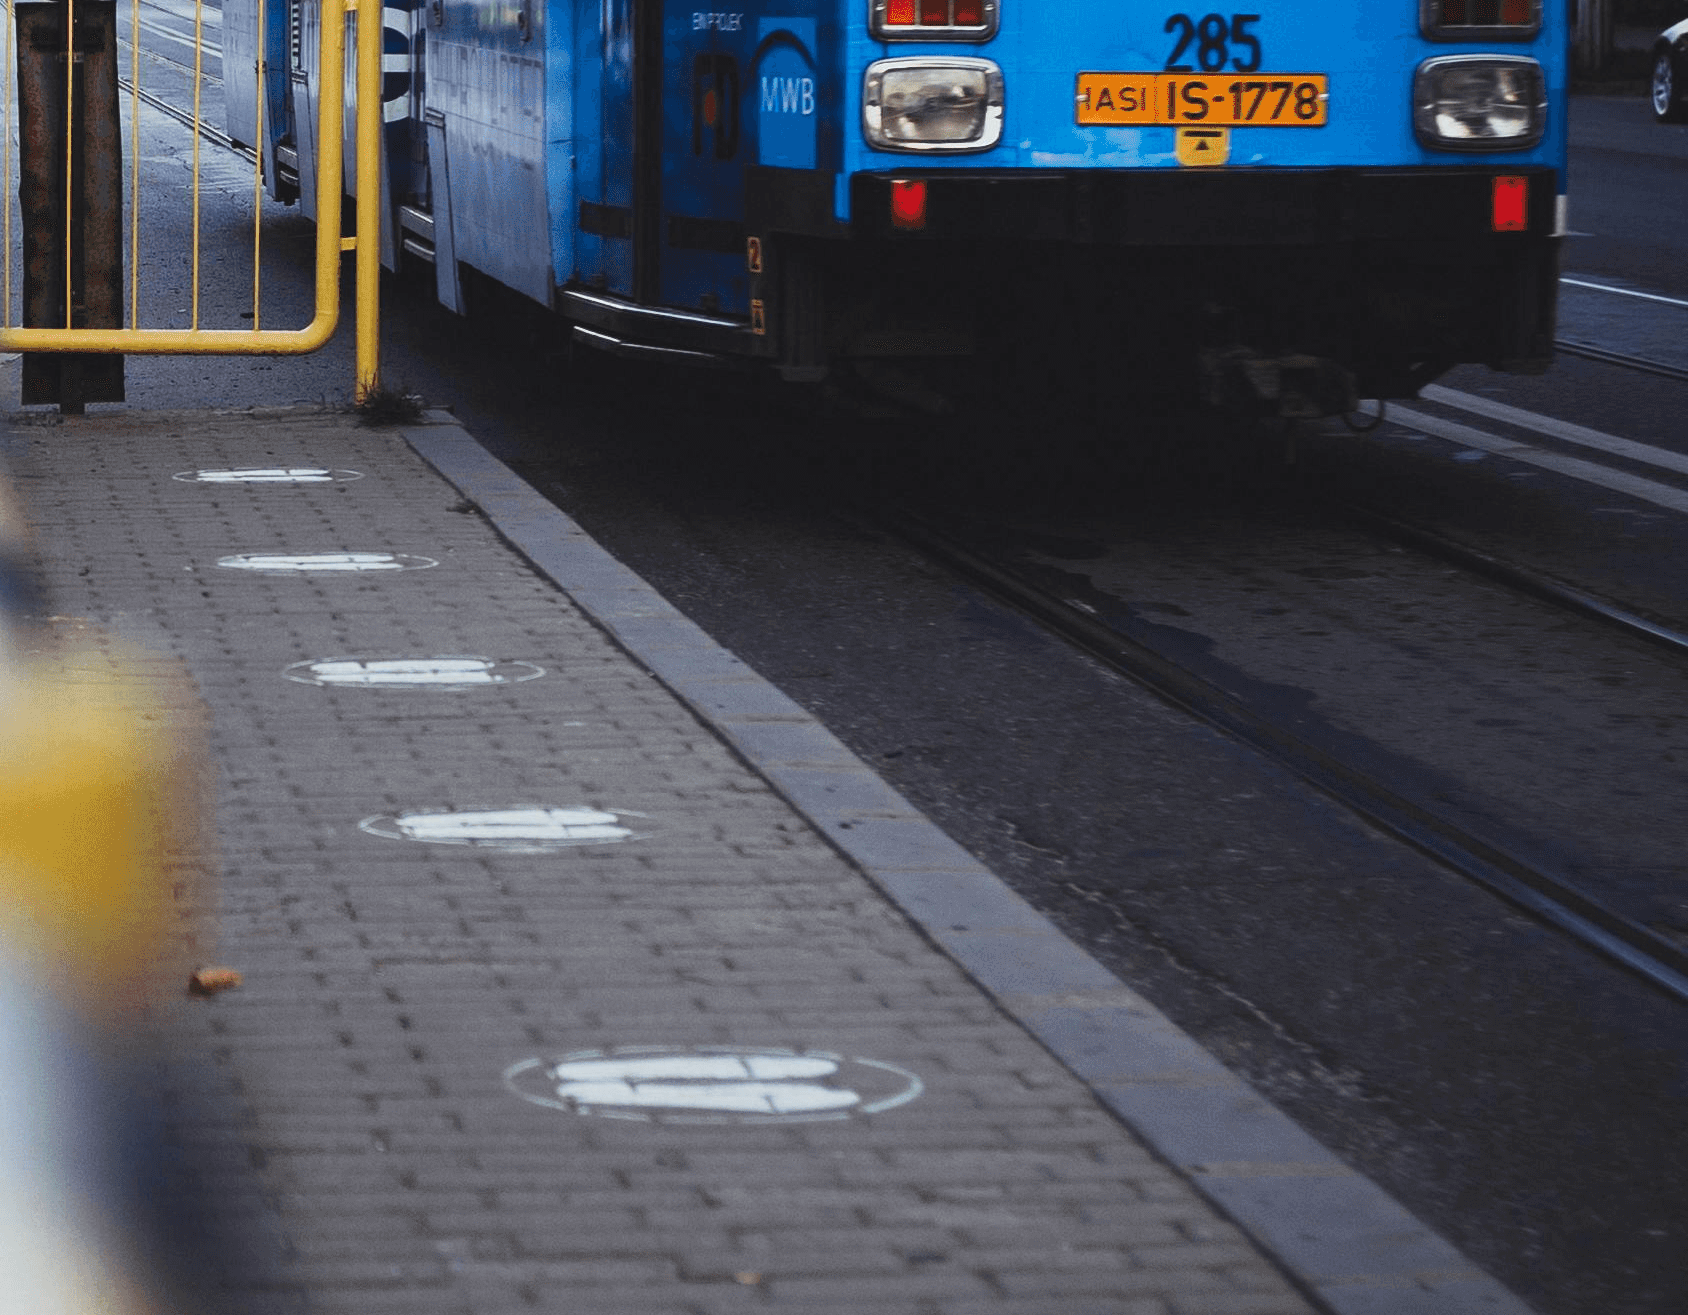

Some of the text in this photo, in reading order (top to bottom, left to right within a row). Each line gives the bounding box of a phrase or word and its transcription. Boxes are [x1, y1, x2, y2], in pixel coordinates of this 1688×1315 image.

[1163, 12, 1262, 72] 285
[761, 76, 815, 114] MWB
[1079, 80, 1320, 121] IASI IS-1778
